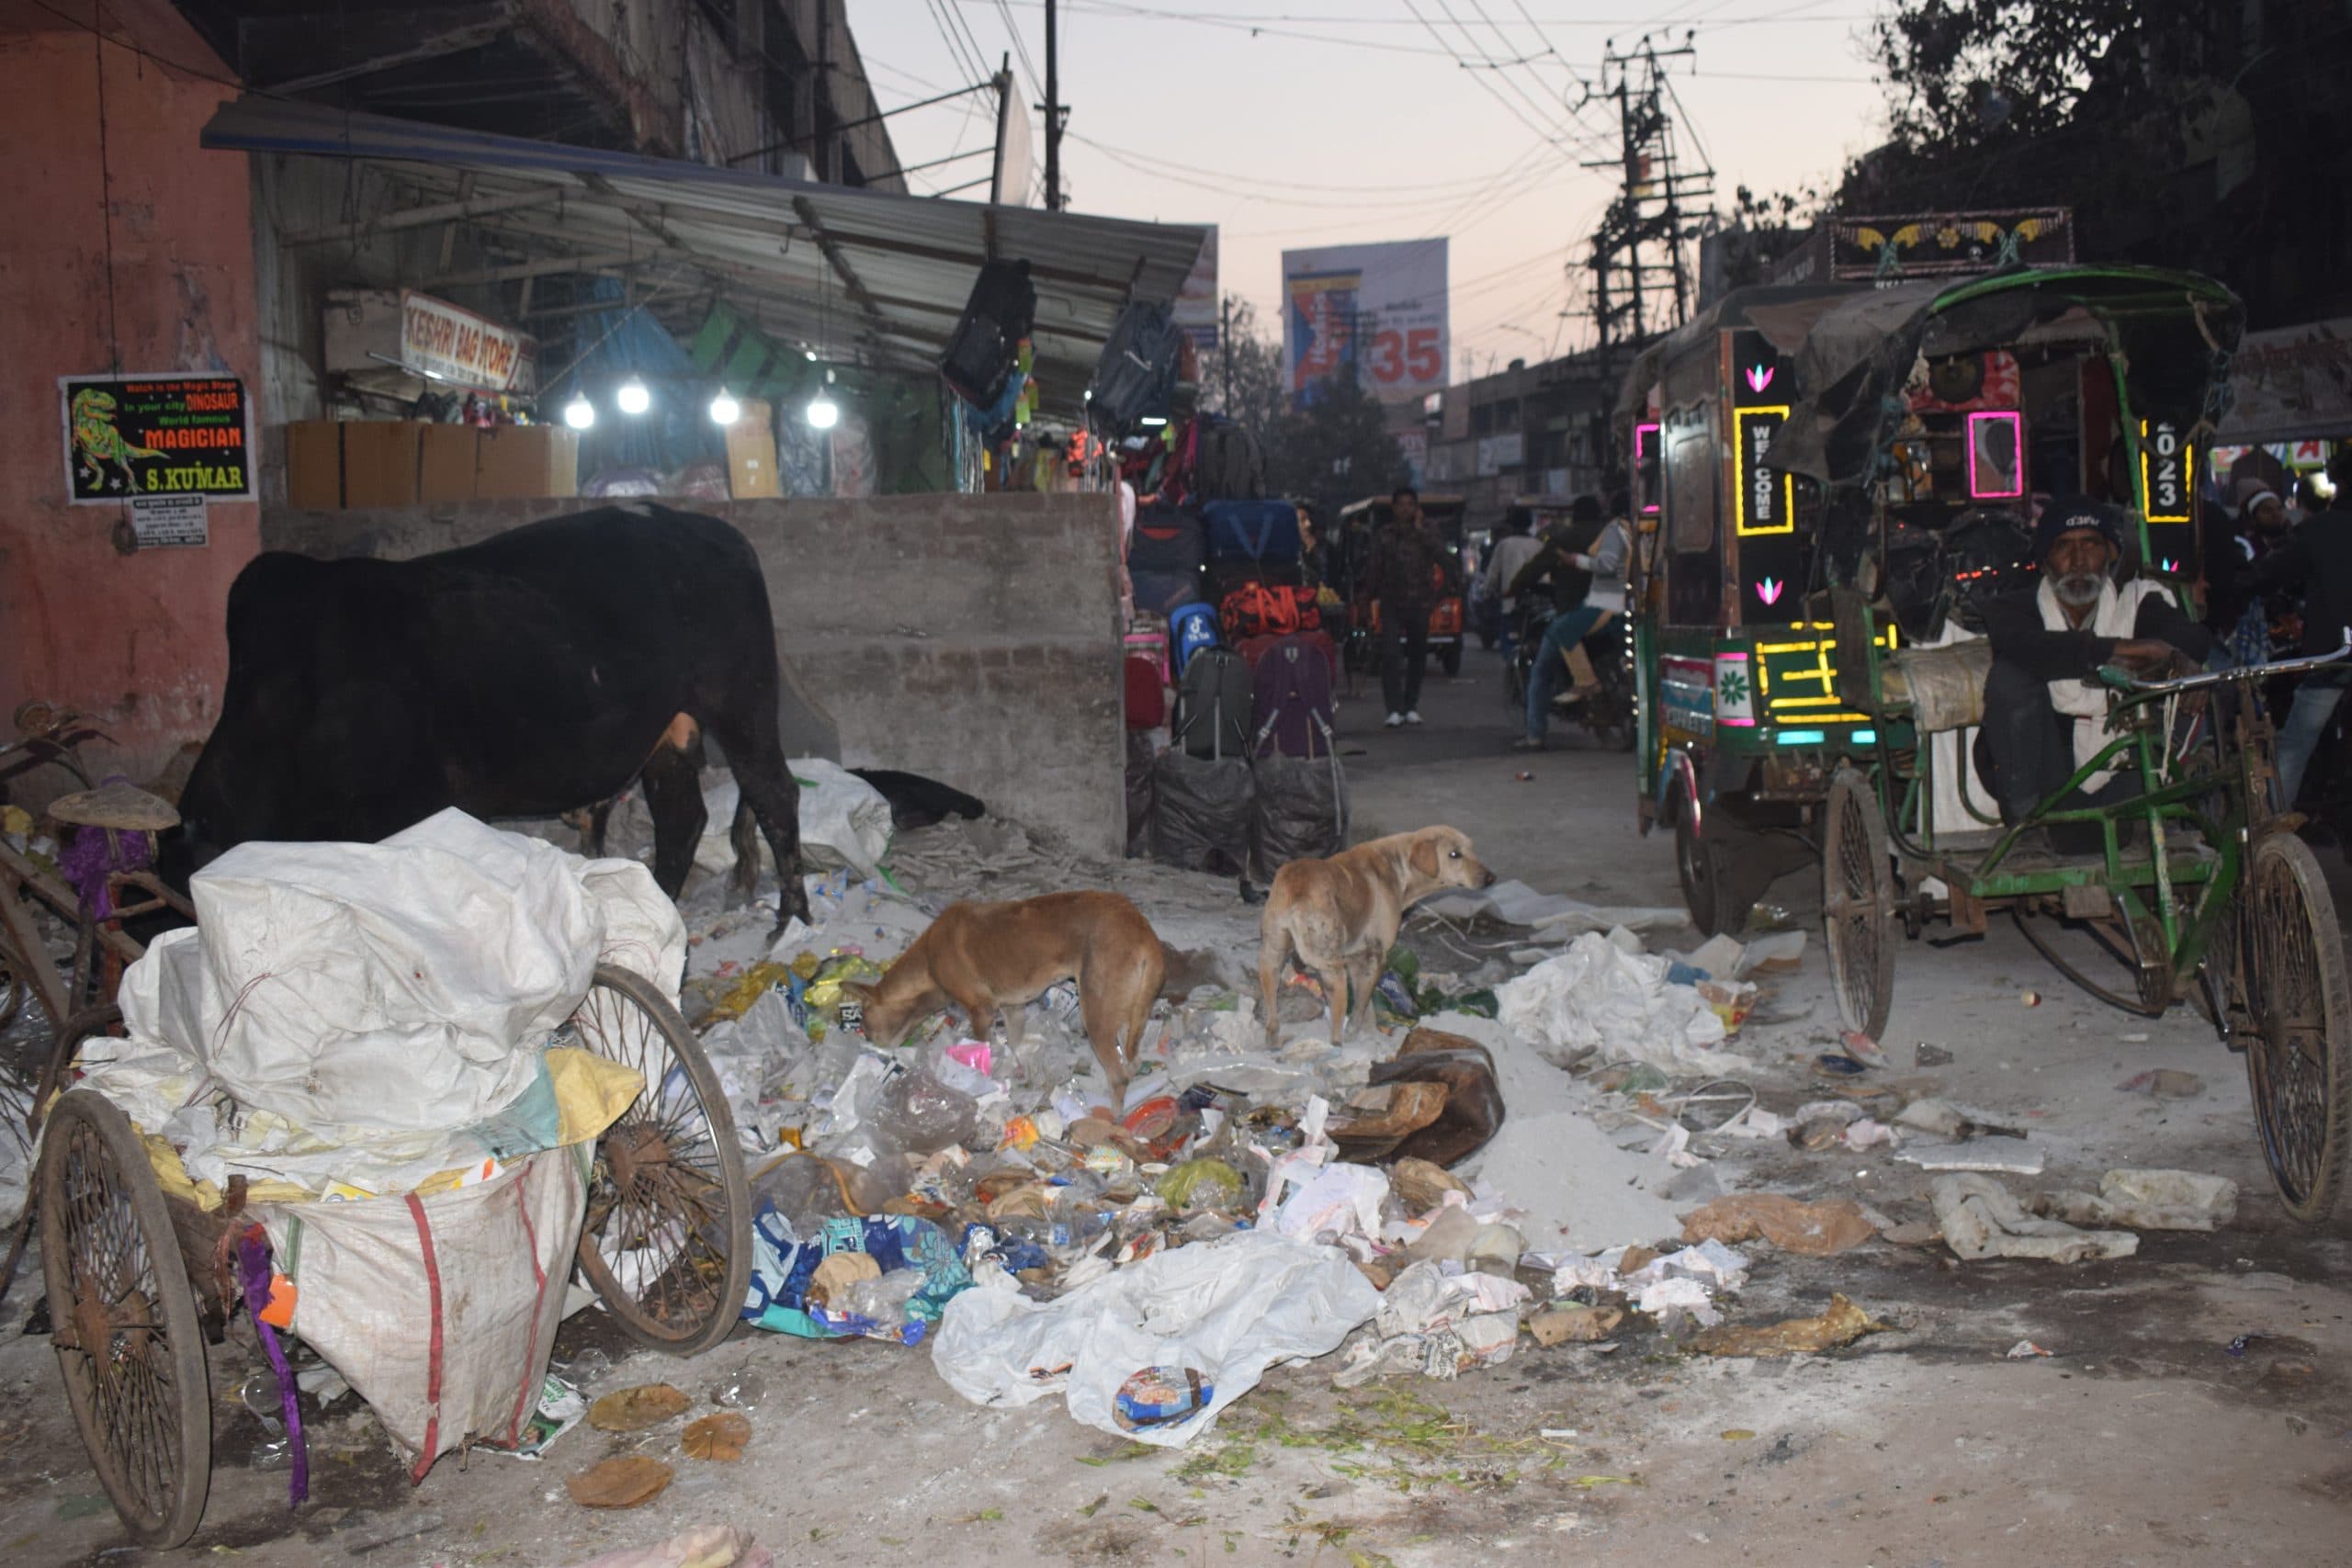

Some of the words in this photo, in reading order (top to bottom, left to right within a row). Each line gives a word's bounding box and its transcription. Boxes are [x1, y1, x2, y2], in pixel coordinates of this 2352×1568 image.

[456, 323, 479, 366] BAG
[1370, 328, 1442, 383] 35
[186, 393, 238, 412] DINOSAUR
[145, 427, 242, 449] MAGICIAN
